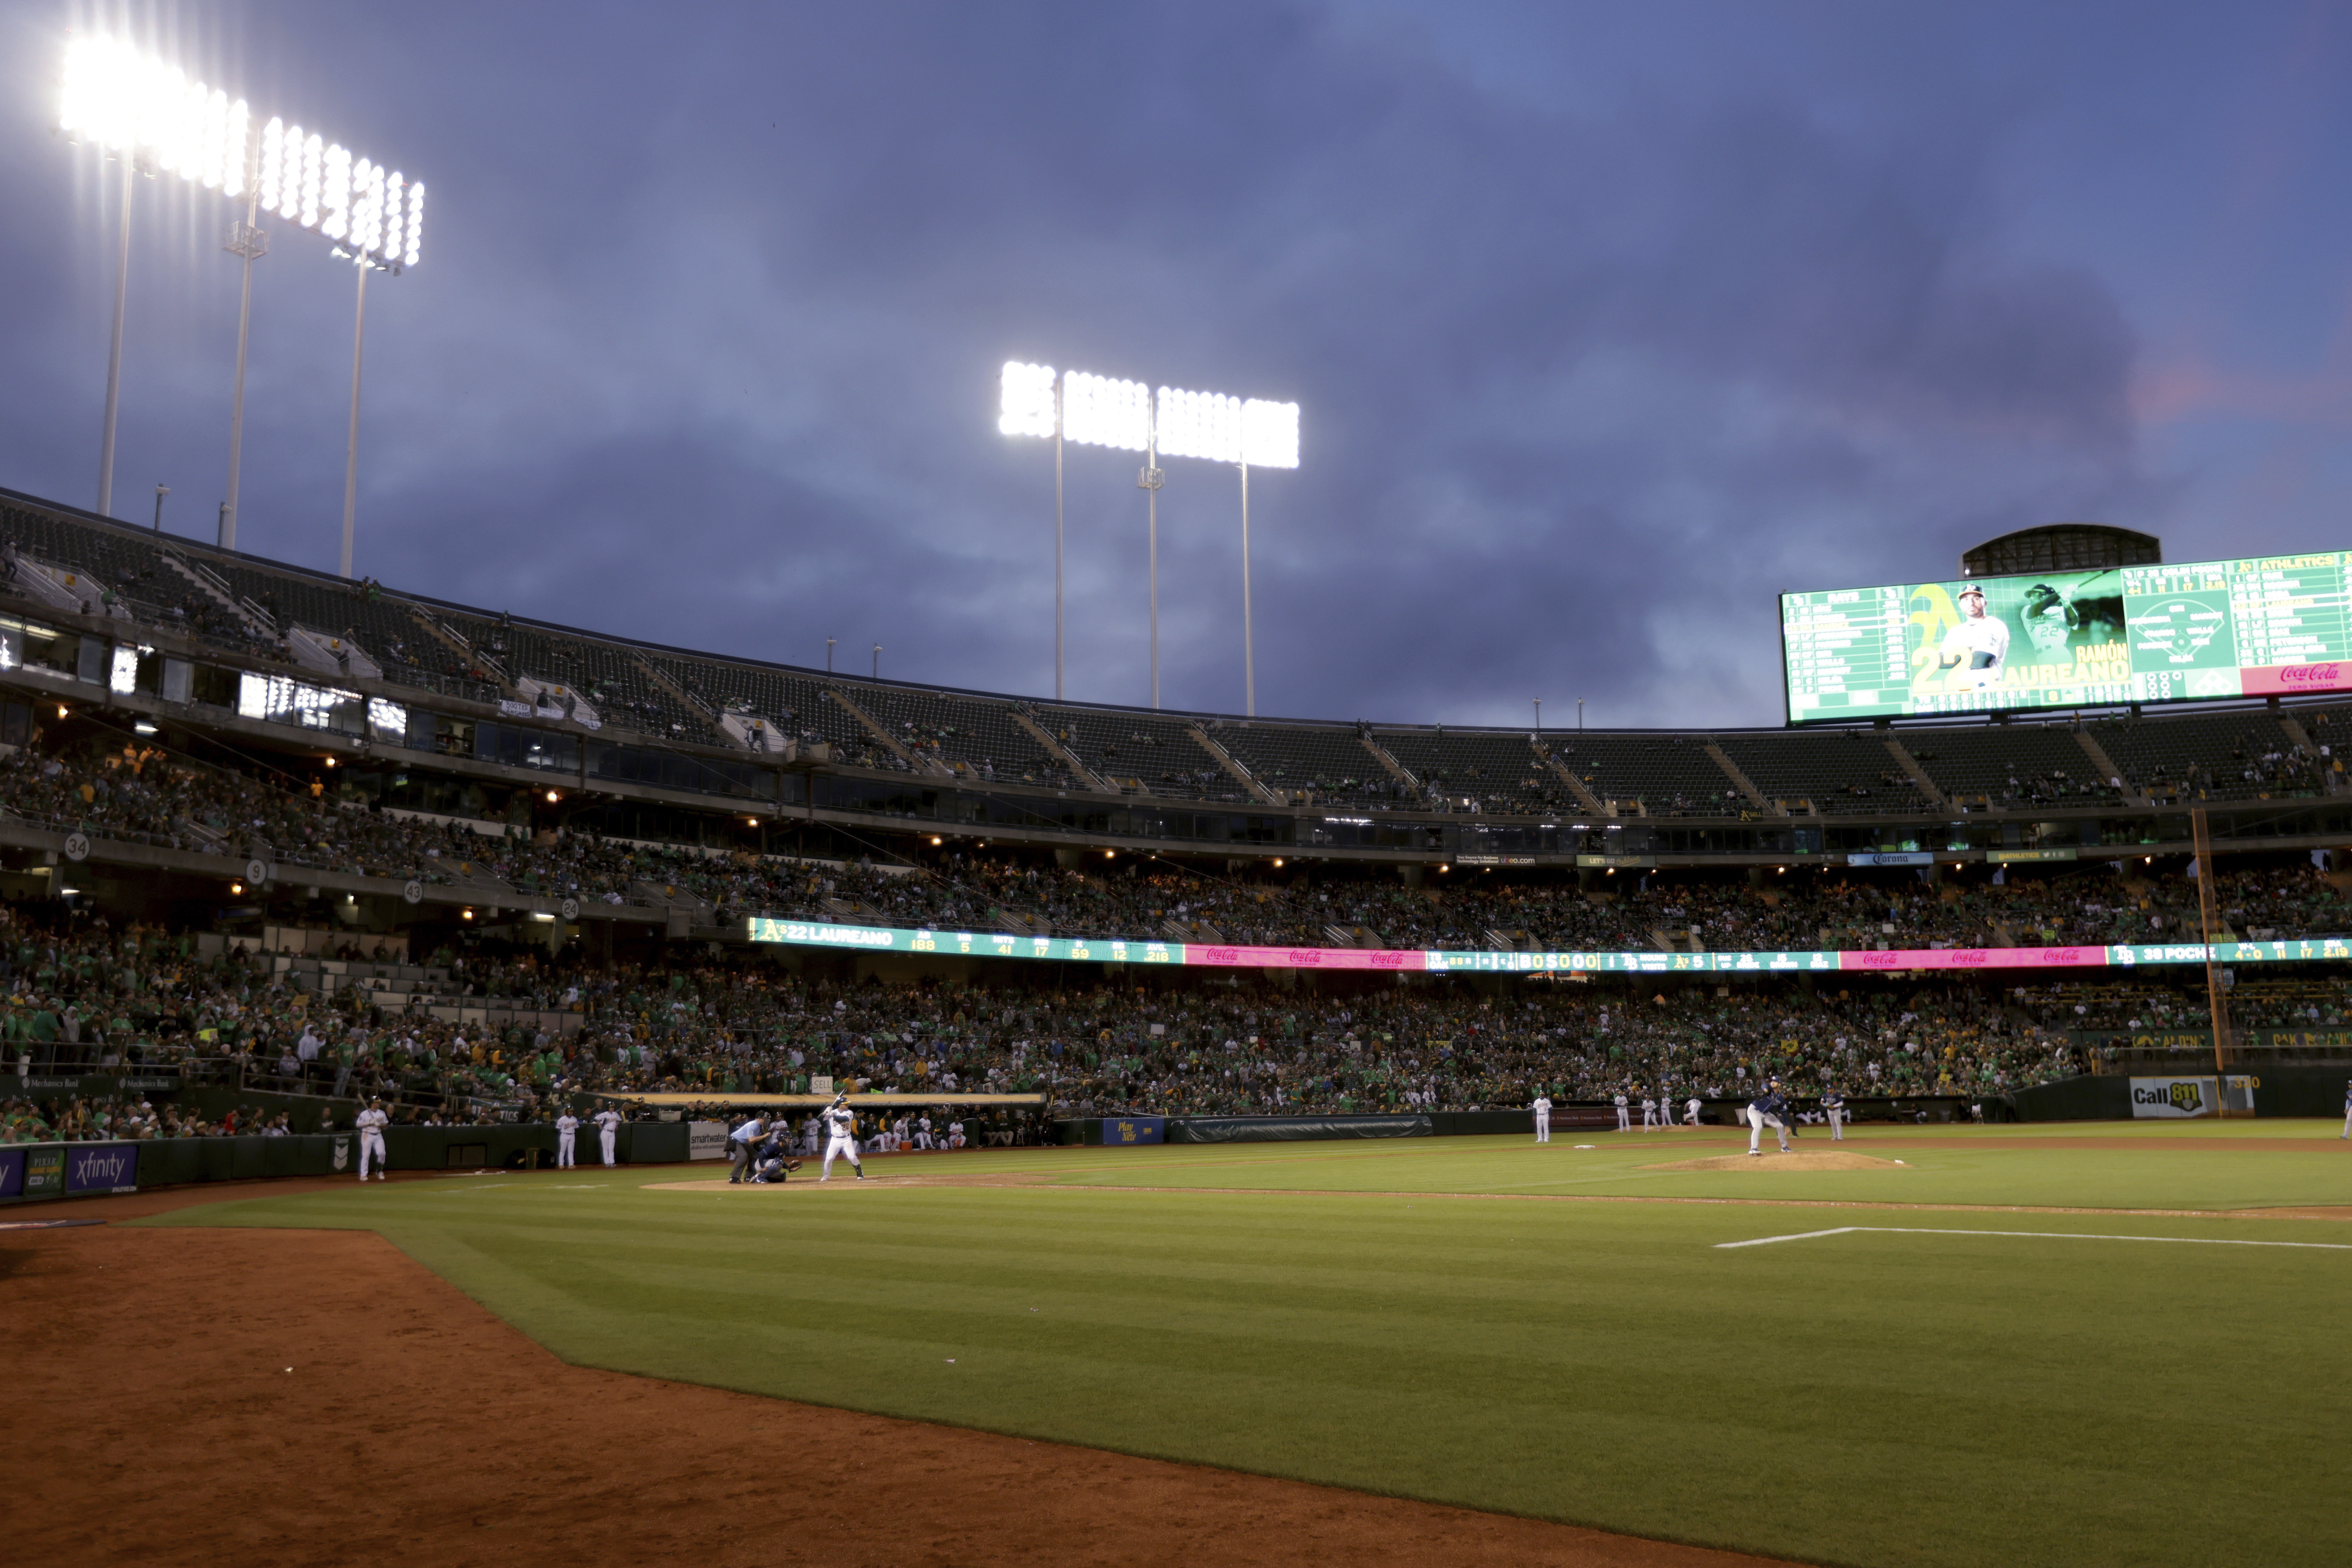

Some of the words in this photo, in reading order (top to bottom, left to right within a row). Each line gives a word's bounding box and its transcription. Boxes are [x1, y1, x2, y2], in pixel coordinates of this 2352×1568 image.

[2260, 555, 2334, 570] ATHLETICS
[2183, 583, 2194, 591] 17
[2206, 580, 2226, 590] 2.19
[1828, 592, 1859, 603] RAYS
[2040, 626, 2059, 637] 22
[2076, 639, 2128, 662] RAMÓN
[1911, 646, 1973, 693] 22
[2280, 662, 2339, 682] Coca-Cola
[2048, 690, 2058, 702] 8
[69, 840, 86, 854] 34
[1617, 855, 1641, 866] Oakland
[1873, 853, 1908, 865] Corona
[252, 866, 261, 878] 9
[407, 886, 420, 898] 43
[564, 904, 577, 915] 24
[787, 926, 807, 939] 22
[810, 927, 893, 946] LAUREANO
[911, 940, 935, 951] 188
[961, 942, 970, 952] 5
[998, 945, 1011, 955] 41
[1036, 946, 1048, 956] 17
[1071, 949, 1089, 959] 59
[1114, 950, 1127, 960] 12
[1144, 951, 1169, 962] .218
[1207, 948, 1238, 960] Coca-Cola
[1290, 950, 1321, 962] Coca-Cola
[1372, 952, 1403, 964] Coca-Cola
[1740, 954, 1753, 962] 26
[1778, 954, 1787, 962] 15
[1813, 953, 1822, 962] 12
[1952, 951, 1986, 963] Coca-Cola
[2044, 949, 2079, 961] Coca-Cola
[2144, 948, 2163, 960] 38
[2277, 950, 2285, 958] 11
[2300, 948, 2312, 958] 17
[2323, 947, 2349, 958] 2.19
[1693, 956, 1703, 968] 5
[1864, 953, 1897, 964] Coca-Cola
[1429, 961, 1449, 969] OAK
[1508, 961, 1514, 969] 0
[127, 1079, 156, 1087] Mechanics
[157, 1079, 169, 1087] Bank
[813, 1080, 831, 1089] SELL
[2234, 1076, 2260, 1088] 330
[2134, 1088, 2167, 1103] Call
[2172, 1083, 2198, 1100] 811
[1118, 1121, 1134, 1132] Play
[691, 1133, 726, 1143] smartwater
[1122, 1132, 1136, 1141] New
[34, 1157, 56, 1167] PIXAR
[76, 1151, 125, 1185] xfinity
